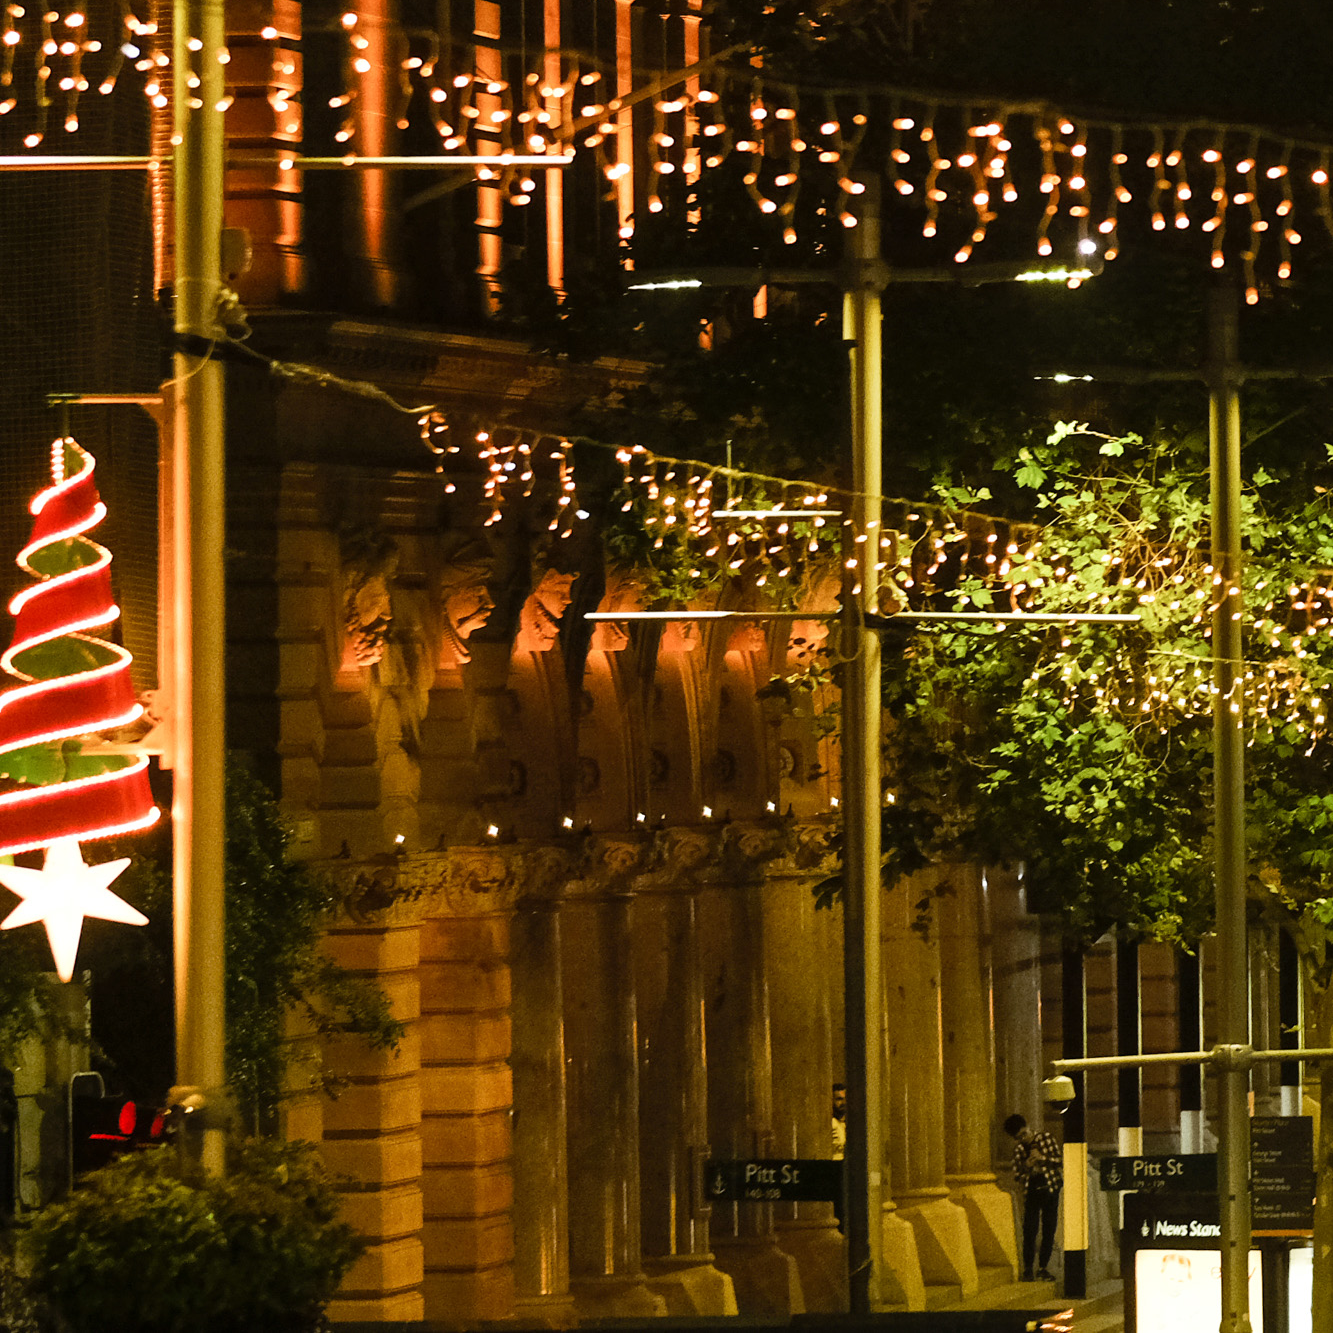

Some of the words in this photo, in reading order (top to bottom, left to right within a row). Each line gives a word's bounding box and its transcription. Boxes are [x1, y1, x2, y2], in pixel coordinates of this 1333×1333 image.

[745, 1163, 777, 1184] Pitt
[780, 1163, 801, 1185] St
[1132, 1160, 1162, 1177] Pitt
[1166, 1158, 1185, 1176] St
[1156, 1219, 1189, 1236] News
